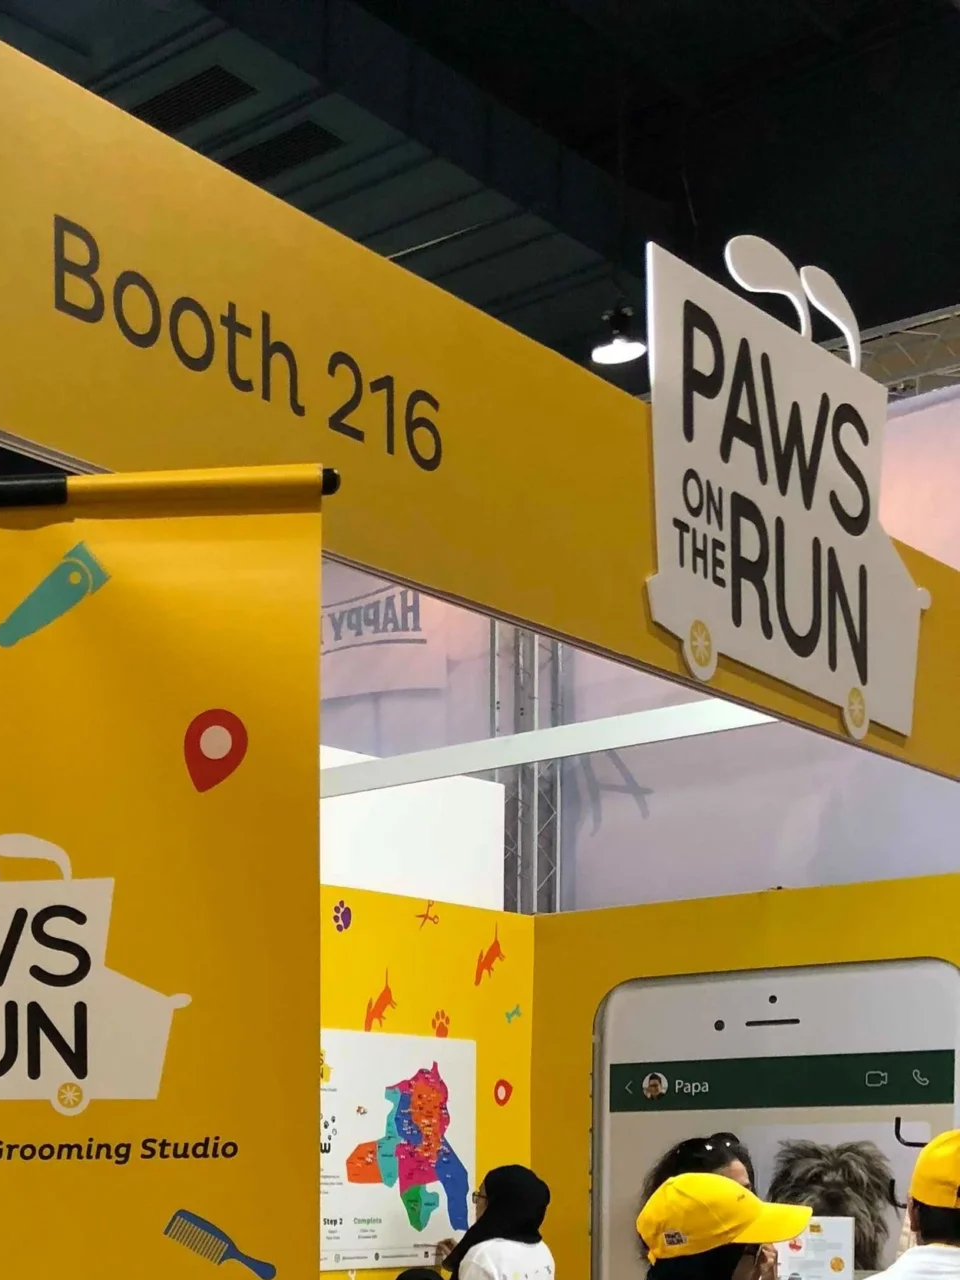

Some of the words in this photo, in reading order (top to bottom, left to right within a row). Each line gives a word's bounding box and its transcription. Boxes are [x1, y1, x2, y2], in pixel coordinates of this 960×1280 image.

[53, 214, 305, 416] Booth
[327, 351, 443, 472] 216
[682, 298, 871, 537] PAWS
[681, 467, 724, 532] ON
[672, 517, 726, 589] THE
[730, 490, 868, 686] RUN
[140, 1135, 239, 1160] Studio
[675, 1080, 709, 1096] Papa
